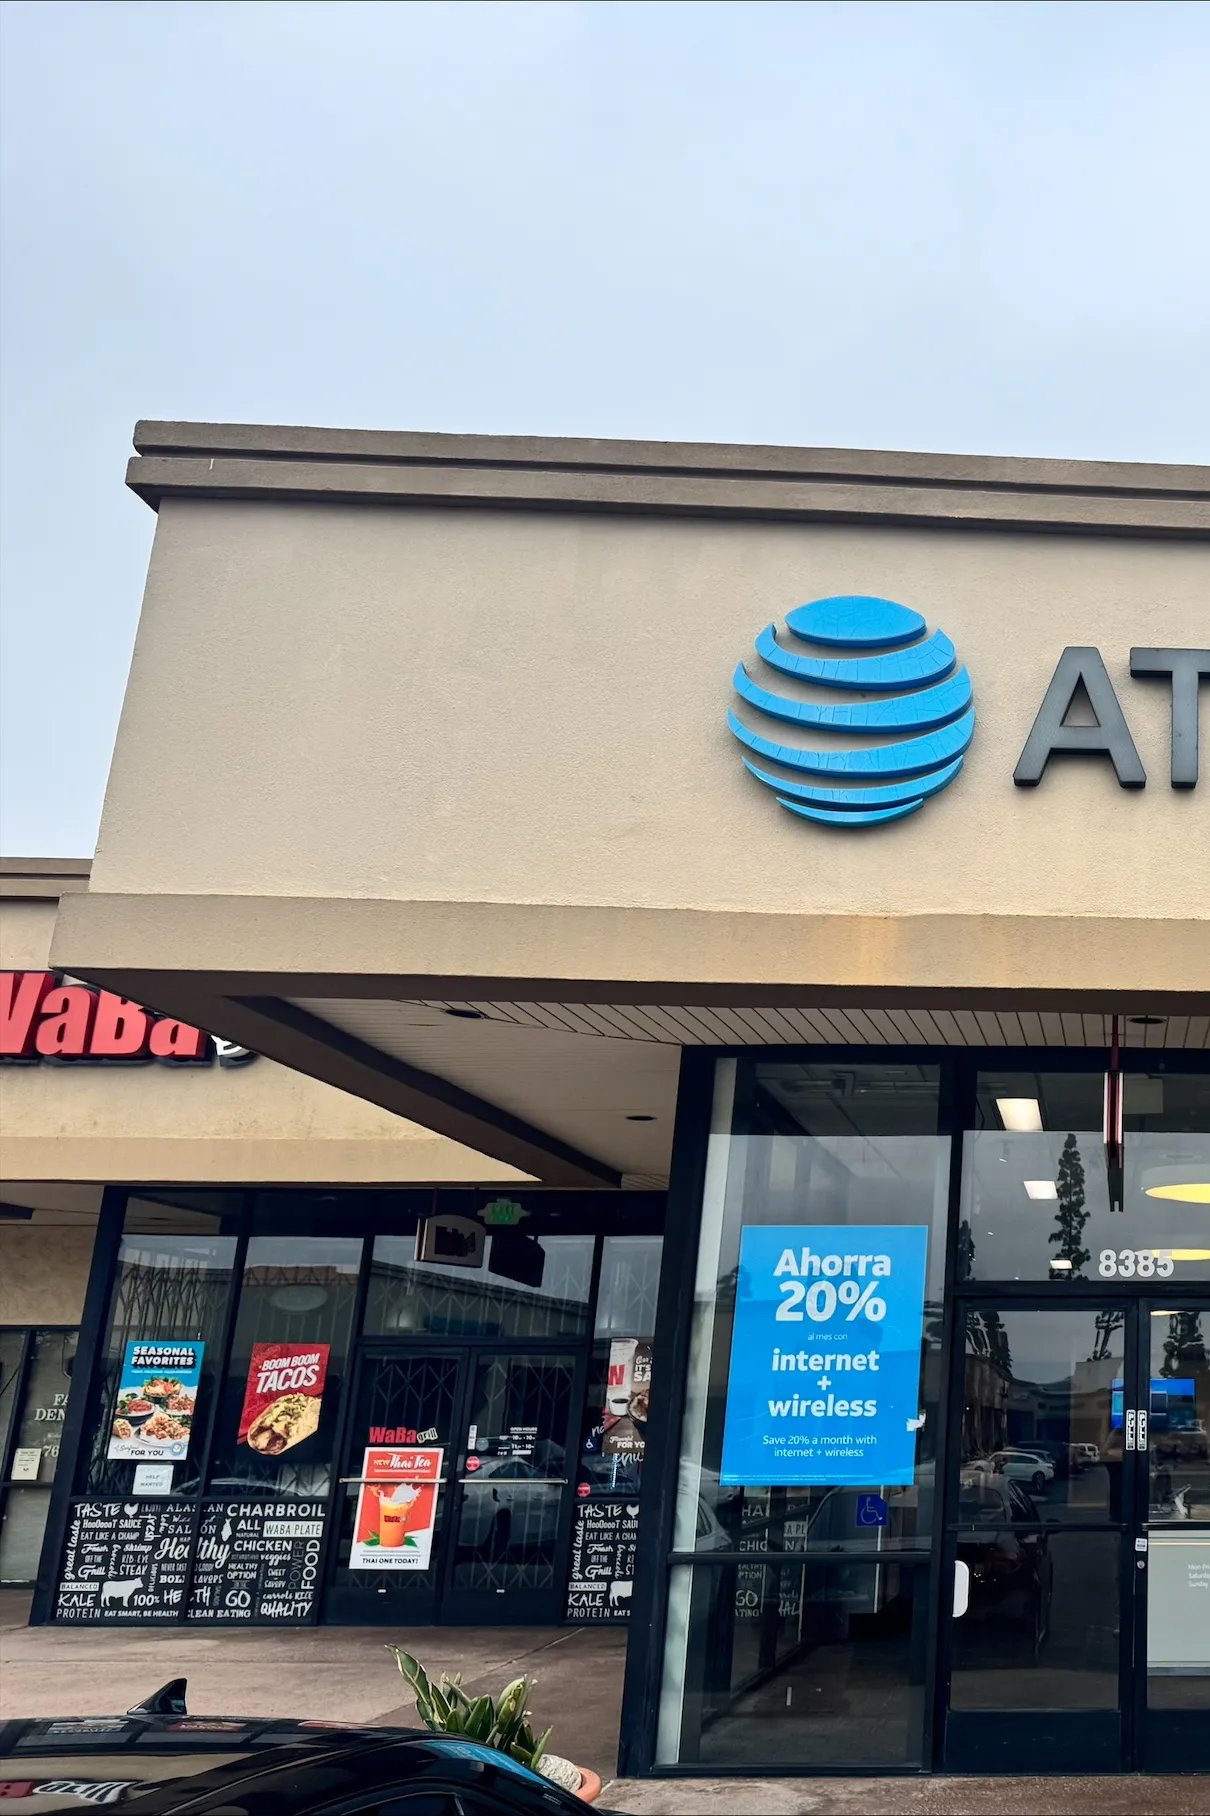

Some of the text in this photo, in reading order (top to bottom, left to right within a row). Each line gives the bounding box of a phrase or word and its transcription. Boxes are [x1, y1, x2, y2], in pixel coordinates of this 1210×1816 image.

[773, 1247, 891, 1276] Ahorra
[1099, 1249, 1174, 1277] 8385
[775, 1280, 887, 1322] 20%
[133, 1346, 194, 1356] SEASONAL
[131, 1356, 193, 1366] FAVORITES
[262, 1353, 320, 1371] BOOM BOOM
[772, 1348, 880, 1371] internet
[256, 1365, 320, 1394] TACOS
[817, 1375, 831, 1391] +
[768, 1393, 877, 1417] wireless
[369, 1427, 438, 1443] WaBa grill
[763, 1435, 786, 1445] Save
[788, 1436, 810, 1445] 20%
[820, 1436, 853, 1445] month
[856, 1436, 877, 1445] with
[774, 1447, 814, 1457] internet
[824, 1447, 864, 1457] wireless
[388, 1452, 414, 1468] Thai
[414, 1454, 432, 1468] Tea
[74, 1502, 122, 1518] TASTE
[227, 1504, 325, 1517] CHARBROIL
[577, 1504, 622, 1518] TASTE
[119, 1519, 142, 1529] SAUCE
[237, 1520, 261, 1530] ALL
[266, 1524, 320, 1534] WABA PLATE
[80, 1532, 93, 1540] EAT
[95, 1532, 109, 1540] LIKE
[111, 1532, 116, 1540] A
[585, 1532, 598, 1540] EAT
[600, 1532, 613, 1540] LIKE
[615, 1532, 620, 1540] A
[123, 1543, 152, 1554] Shrimp
[234, 1540, 292, 1552] CHICKEN
[260, 1554, 291, 1566] veggies
[288, 1540, 304, 1590] POWER
[301, 1540, 320, 1590] FOOD
[120, 1564, 148, 1576] STEAK
[227, 1571, 256, 1580] OPTION
[58, 1593, 96, 1608] KALE
[133, 1594, 160, 1606] 100%
[225, 1590, 251, 1607] GO
[568, 1593, 604, 1607] KALE
[56, 1608, 100, 1618] PROTEIN
[217, 1609, 251, 1618] EATING
[260, 1601, 312, 1618] QUALITY
[567, 1608, 610, 1618] PROTEIN
